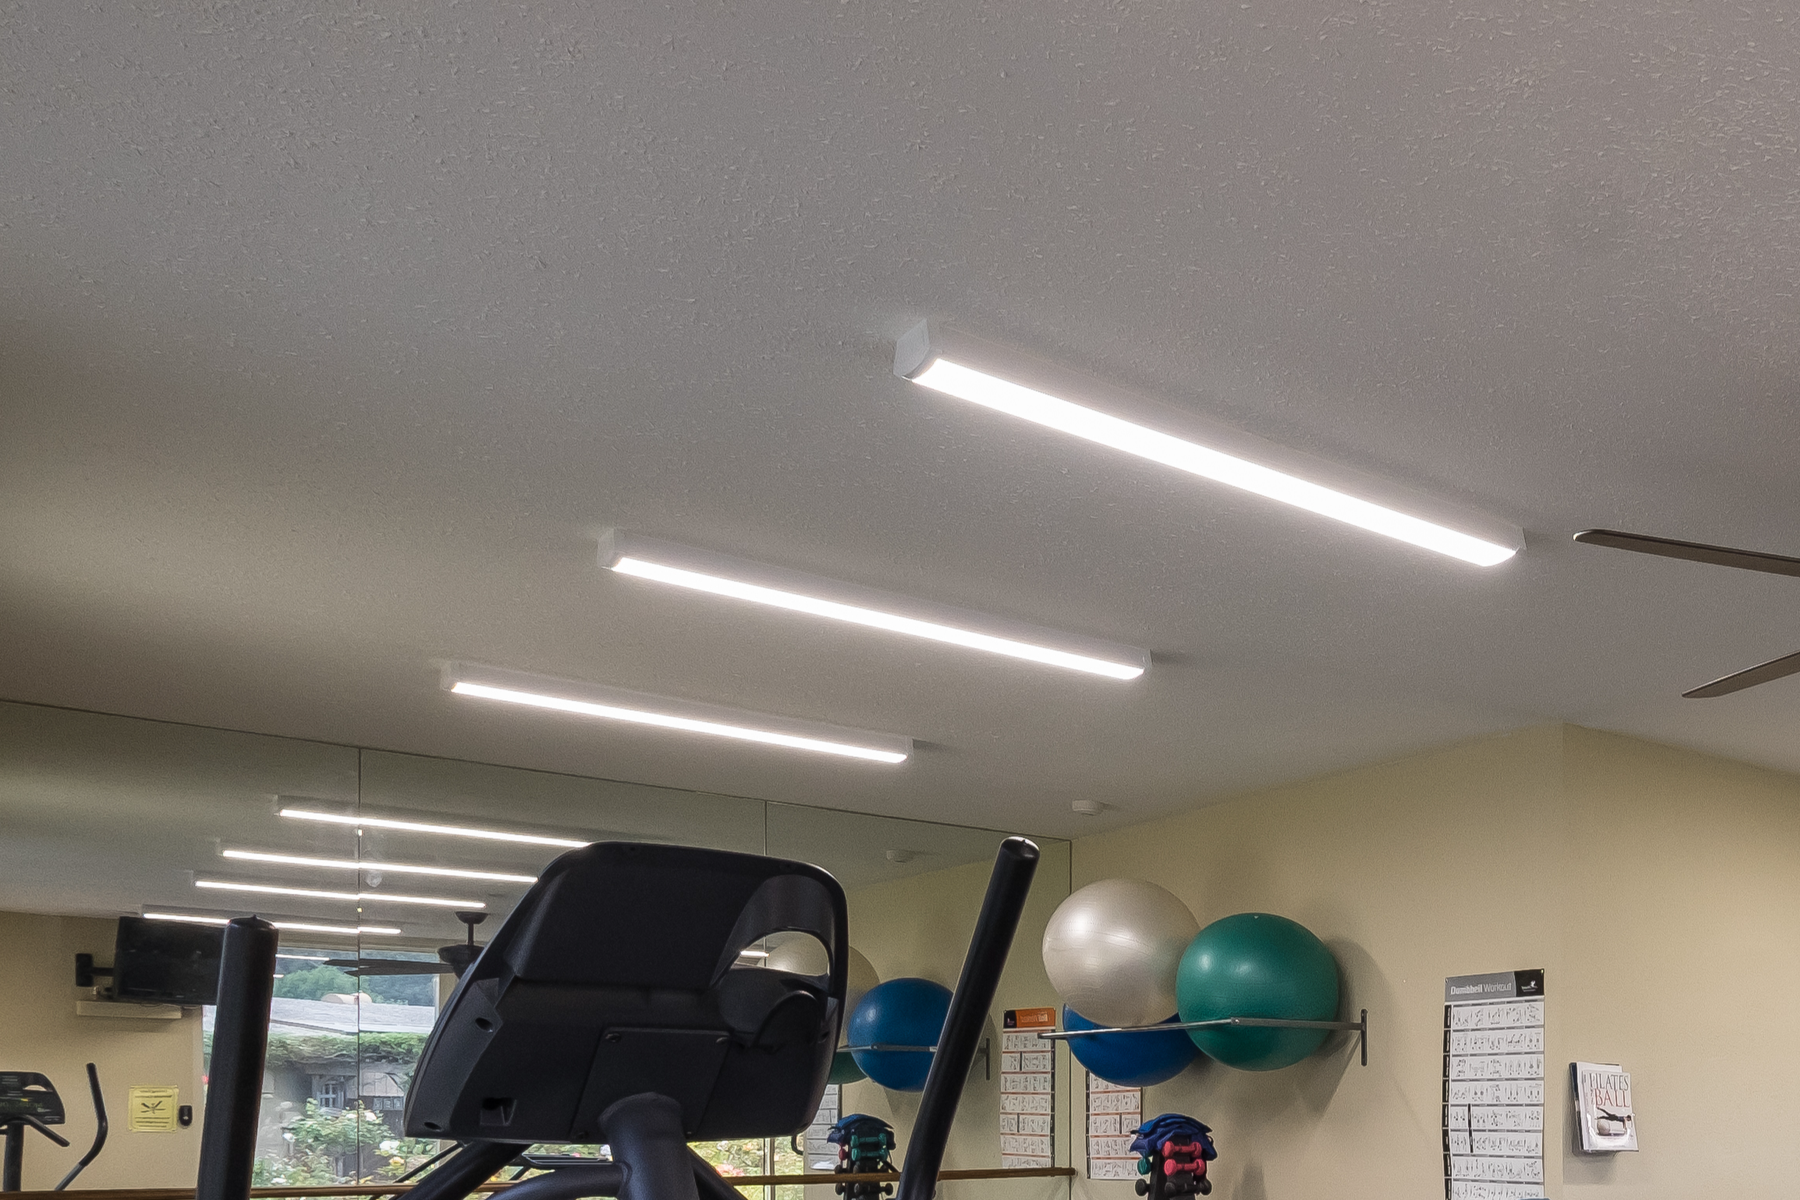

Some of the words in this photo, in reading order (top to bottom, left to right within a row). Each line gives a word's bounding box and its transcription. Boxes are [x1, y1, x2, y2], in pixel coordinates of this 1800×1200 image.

[1450, 984, 1483, 995] Dumbbell
[1483, 982, 1512, 993] Workout
[1589, 1072, 1629, 1092] PILATES
[1594, 1088, 1630, 1108] BALL
